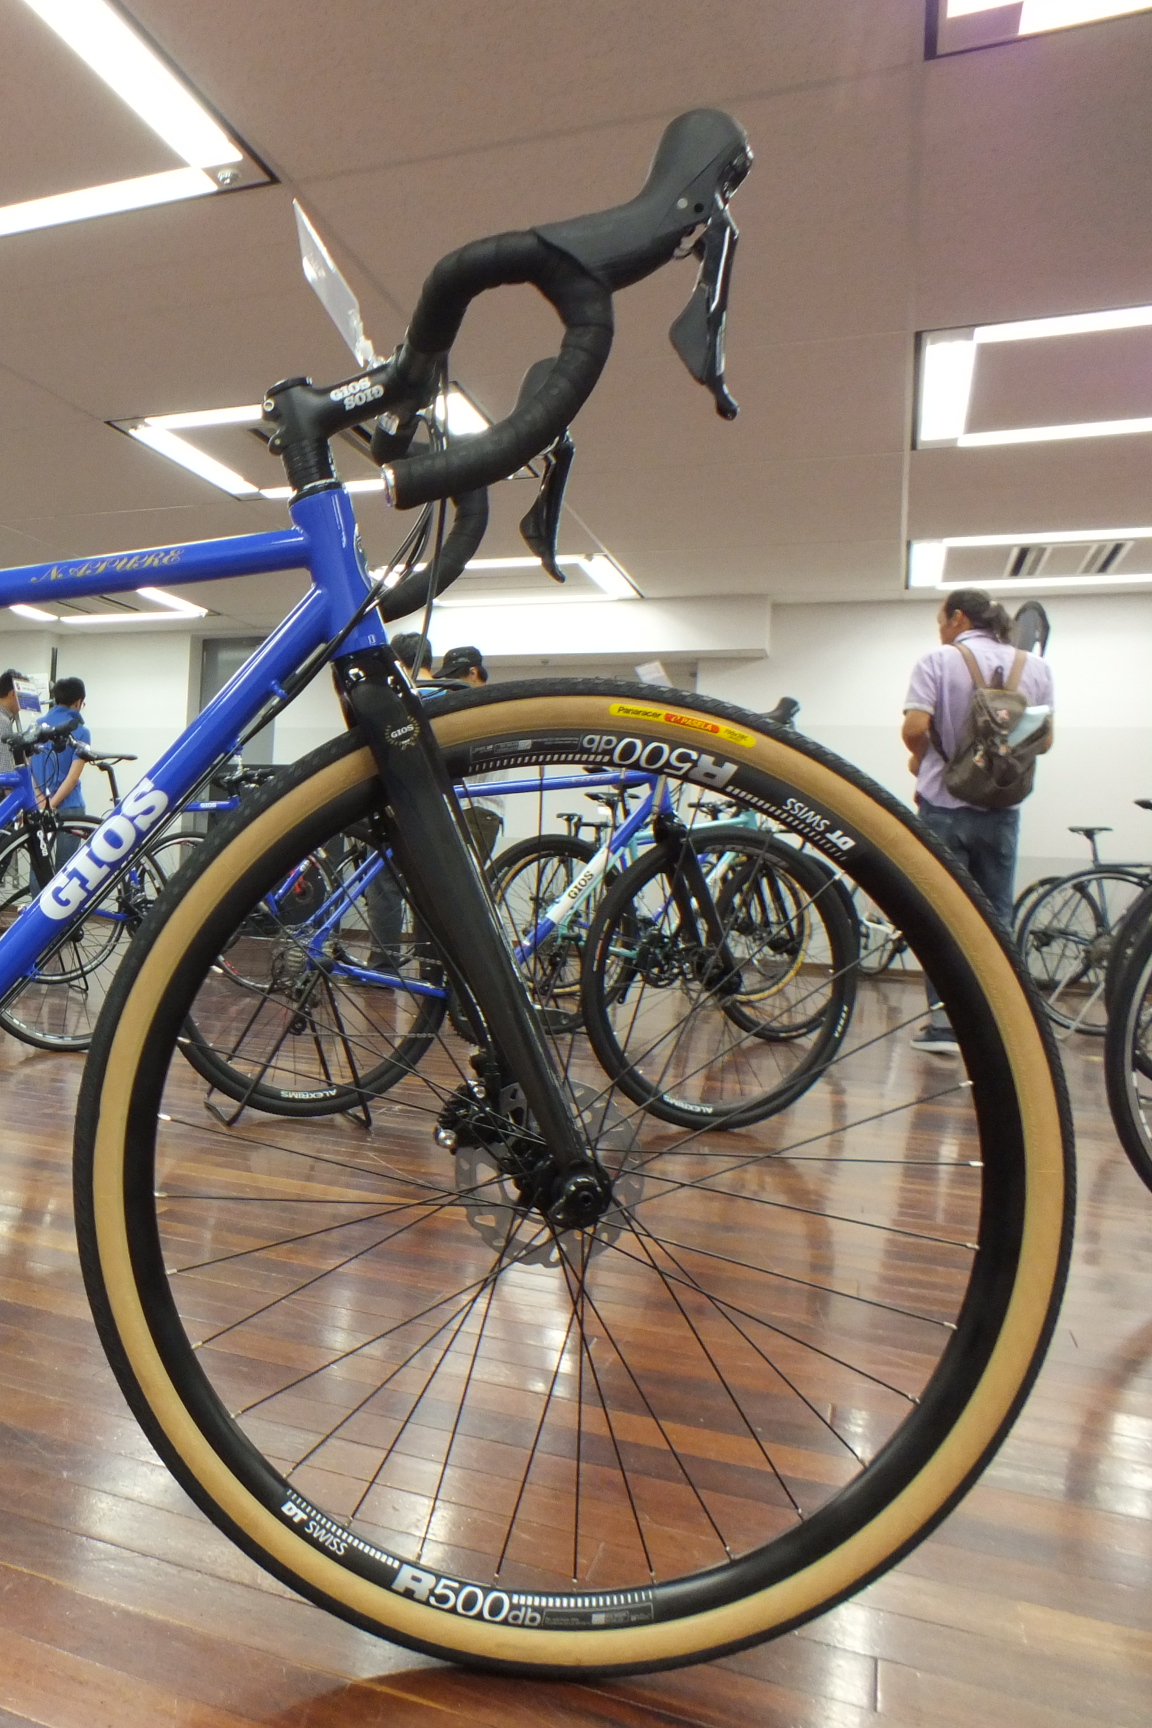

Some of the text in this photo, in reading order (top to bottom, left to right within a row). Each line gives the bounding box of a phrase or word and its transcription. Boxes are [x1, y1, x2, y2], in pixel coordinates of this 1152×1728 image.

[330, 376, 371, 401] GIOS
[344, 384, 384, 411] GIOS
[28, 549, 185, 584] NATURE
[390, 724, 414, 738] GIOS
[617, 706, 662, 719] Panaracer
[681, 718, 713, 731] PASELA
[782, 798, 856, 851] DT SWISS
[39, 777, 169, 920] GIOS
[568, 870, 594, 899] GIOS
[280, 1088, 338, 1101] ALEXRIMS
[281, 1501, 348, 1556] DT SWISS
